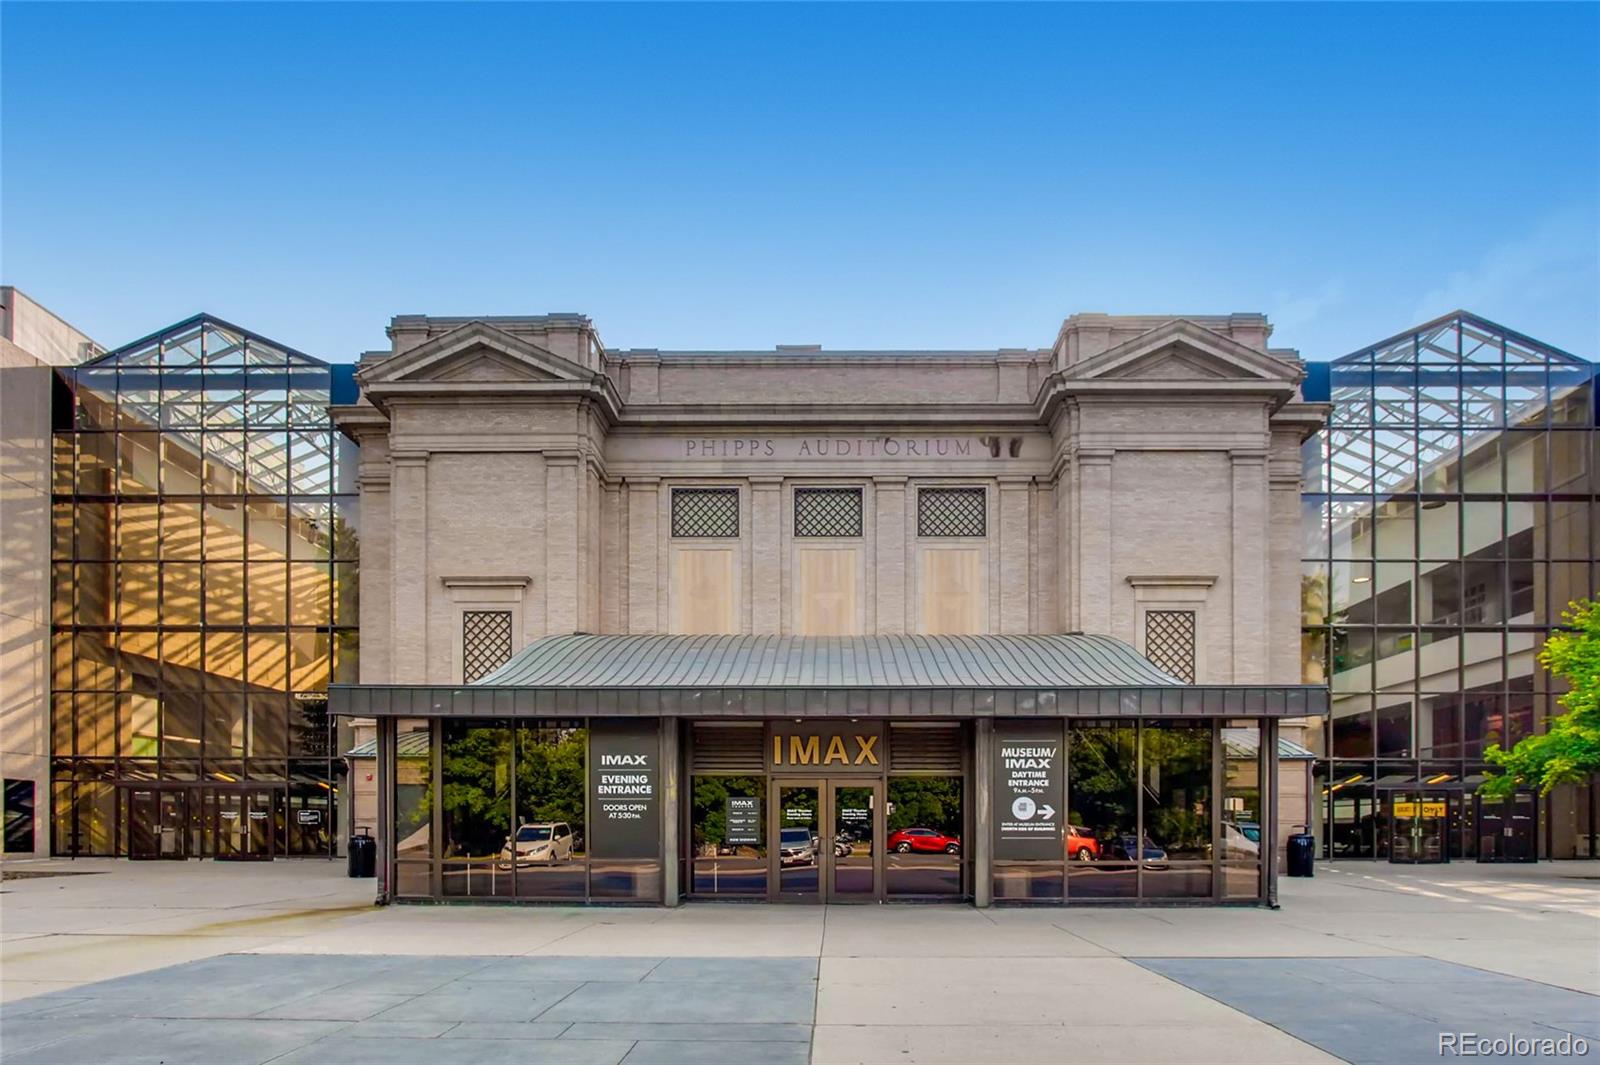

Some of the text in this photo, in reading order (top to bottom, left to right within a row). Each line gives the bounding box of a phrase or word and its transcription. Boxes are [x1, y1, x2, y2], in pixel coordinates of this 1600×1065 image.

[686, 438, 971, 456] PHIPPS AUDITORIUM
[773, 735, 879, 765] IMAX
[1001, 747, 1057, 758] MUSEUM/
[601, 755, 647, 765] IMAX
[1005, 758, 1051, 769] IMAX
[601, 775, 648, 784] EVENING
[1008, 779, 1049, 787] ENTRANCE
[598, 785, 652, 794] ENTRANCE
